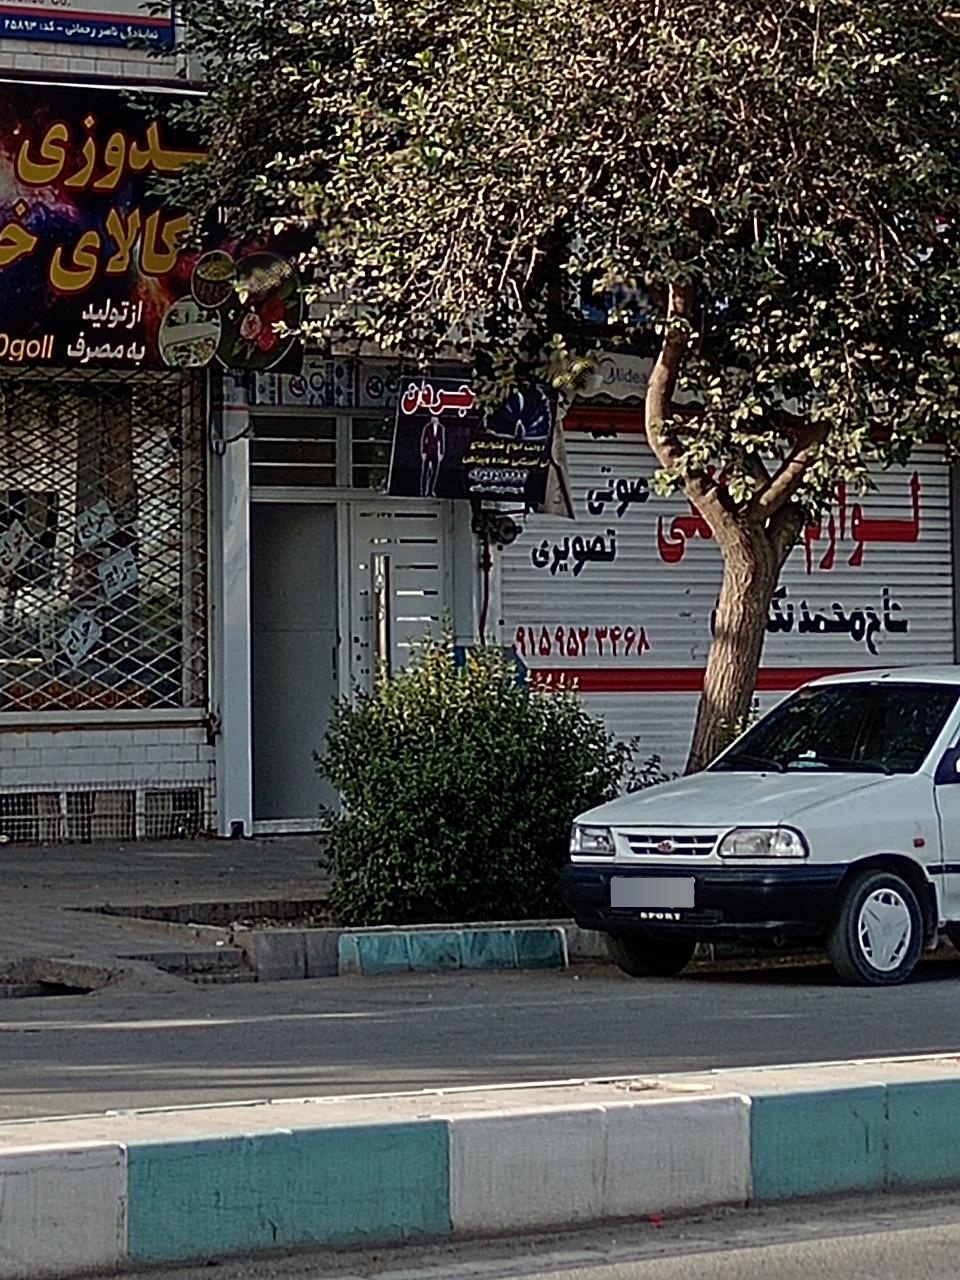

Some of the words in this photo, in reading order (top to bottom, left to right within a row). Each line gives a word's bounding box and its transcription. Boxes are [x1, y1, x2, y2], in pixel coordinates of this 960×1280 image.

[49, 207, 191, 291] کالای
[82, 298, 127, 328] تولید
[67, 331, 125, 364] مصرف
[126, 339, 146, 365] به
[531, 528, 616, 577] تصویری
